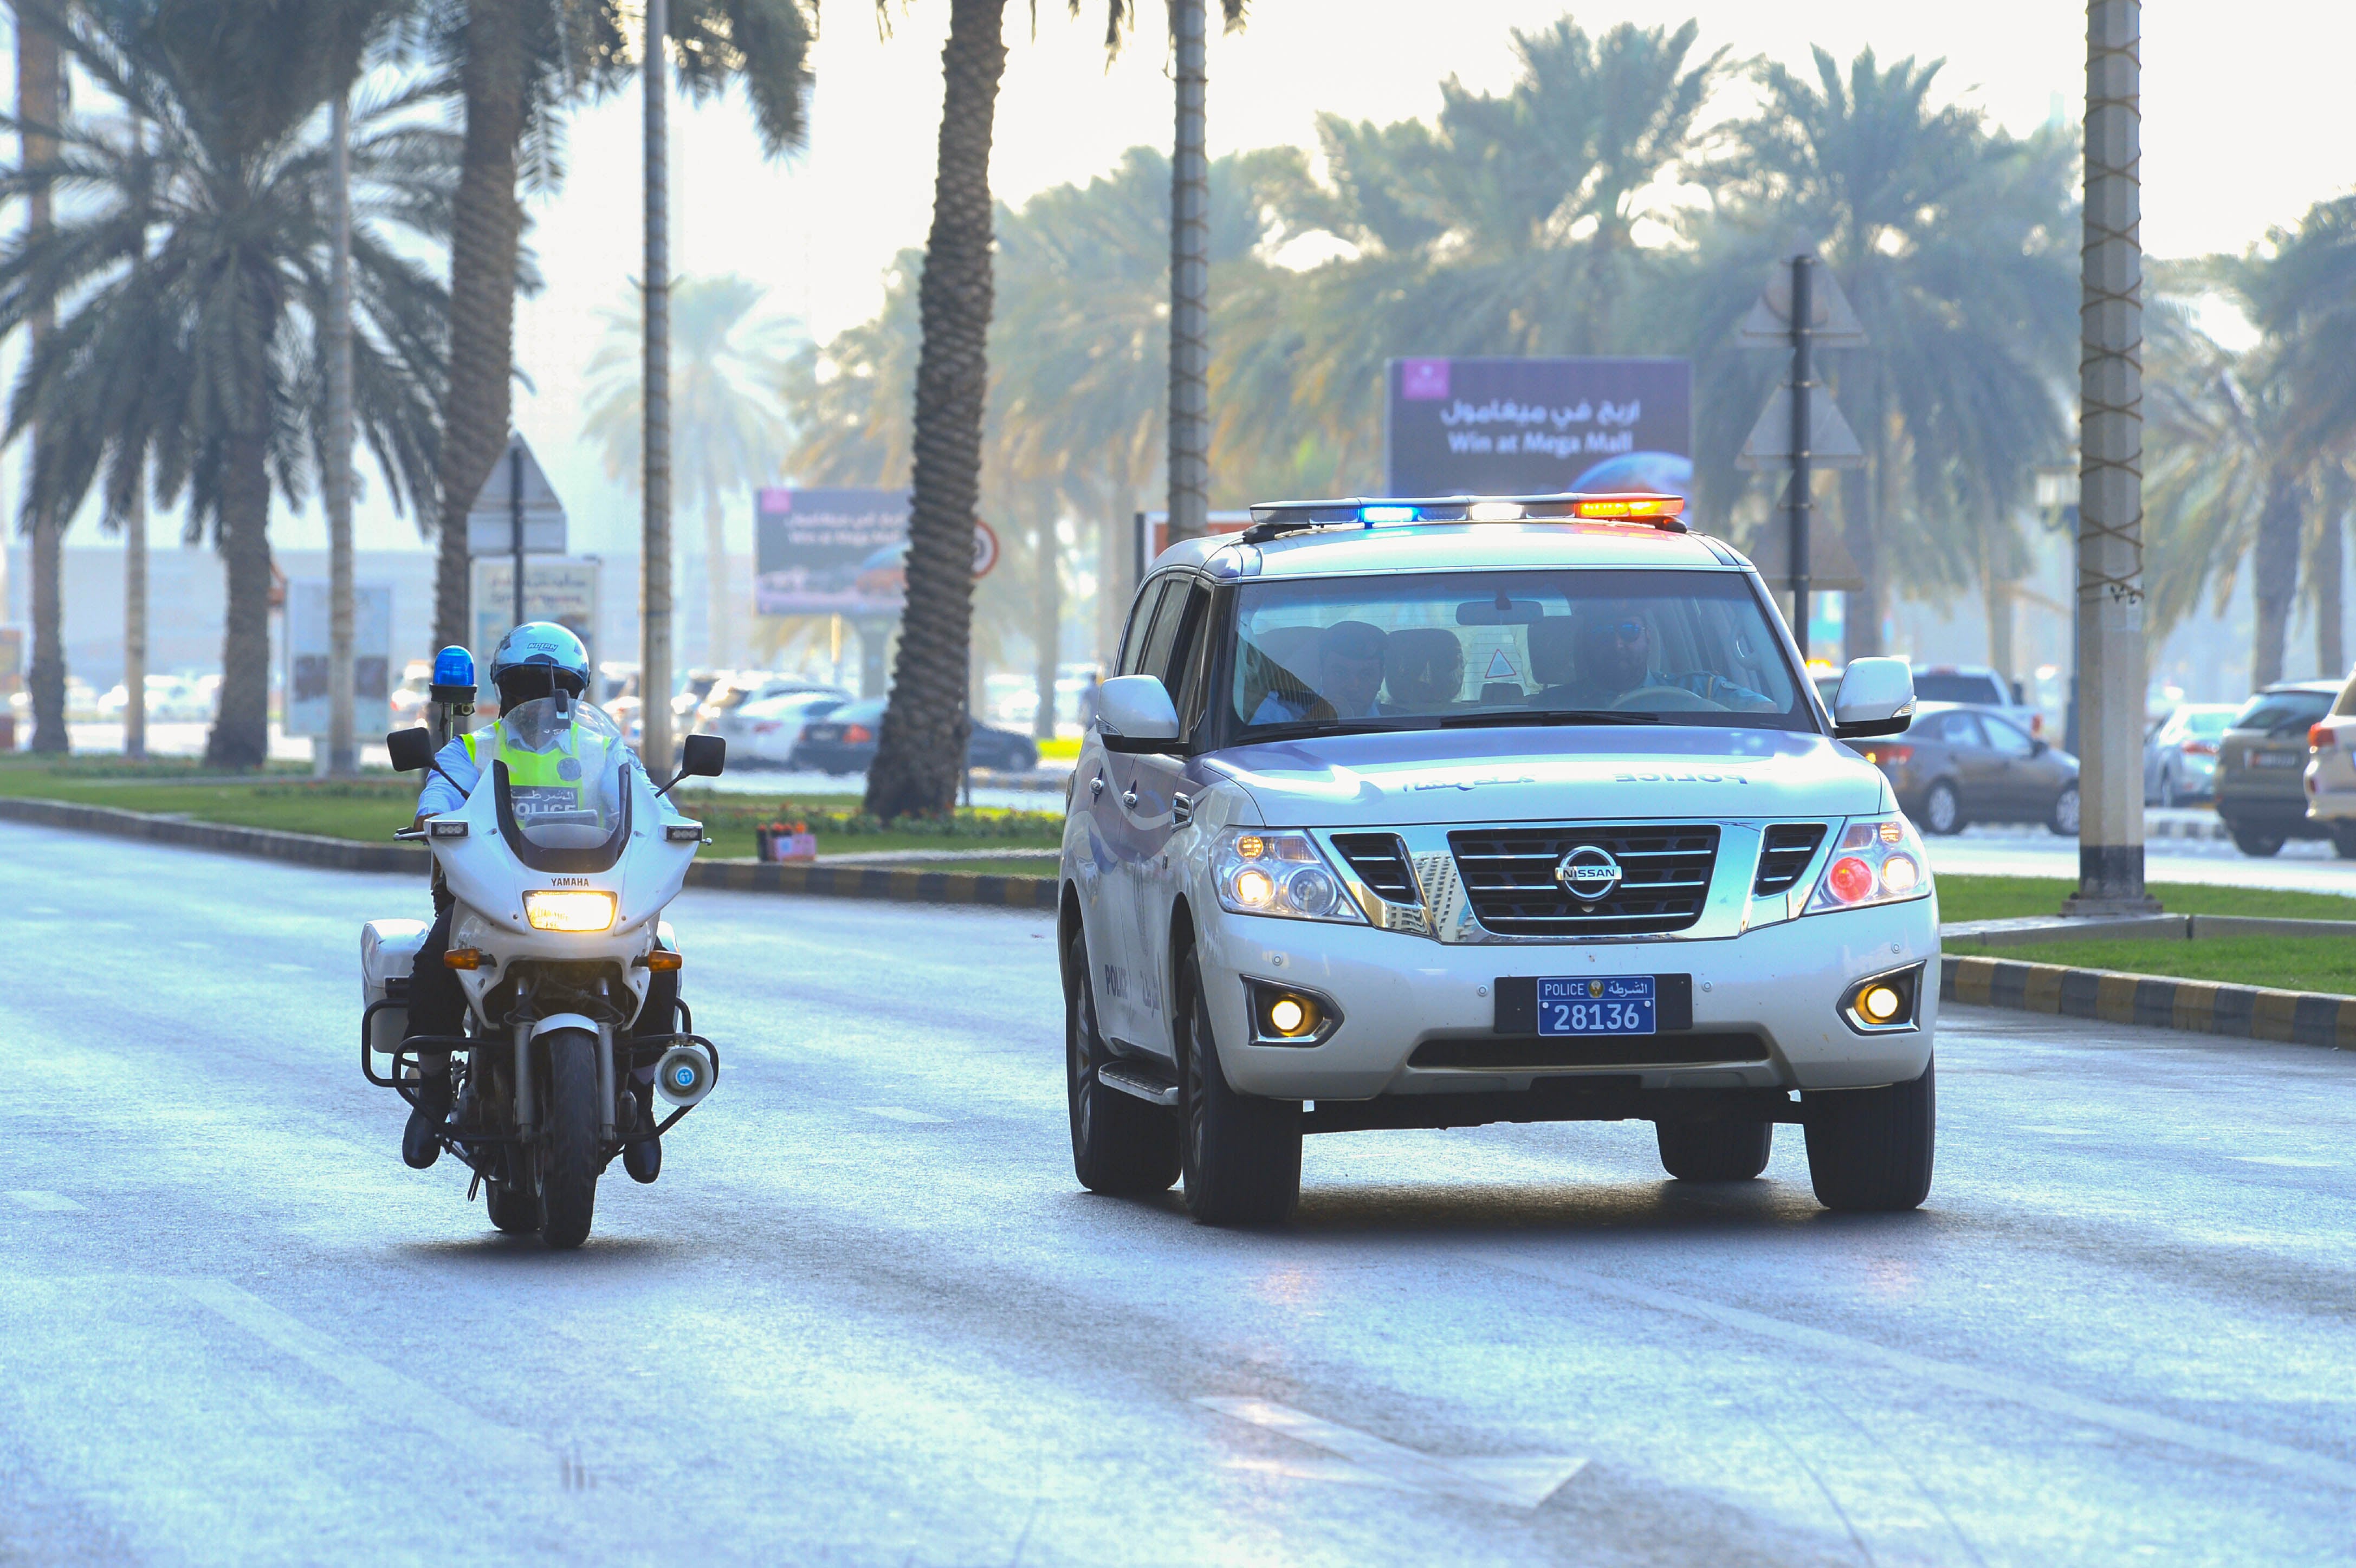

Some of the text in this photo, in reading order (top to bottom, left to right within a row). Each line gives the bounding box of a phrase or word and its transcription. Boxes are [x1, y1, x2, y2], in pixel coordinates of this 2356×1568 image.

[1550, 397, 1592, 431] في
[1447, 431, 1633, 459] Win at Mega Mall
[512, 802, 576, 816] OLICE
[1563, 869, 1615, 877] NISSAN
[551, 878, 589, 887] YAMAHA
[1545, 983, 1584, 996] POLICE
[1608, 981, 1647, 997] الشرطة
[1554, 1004, 1639, 1031] 28136
